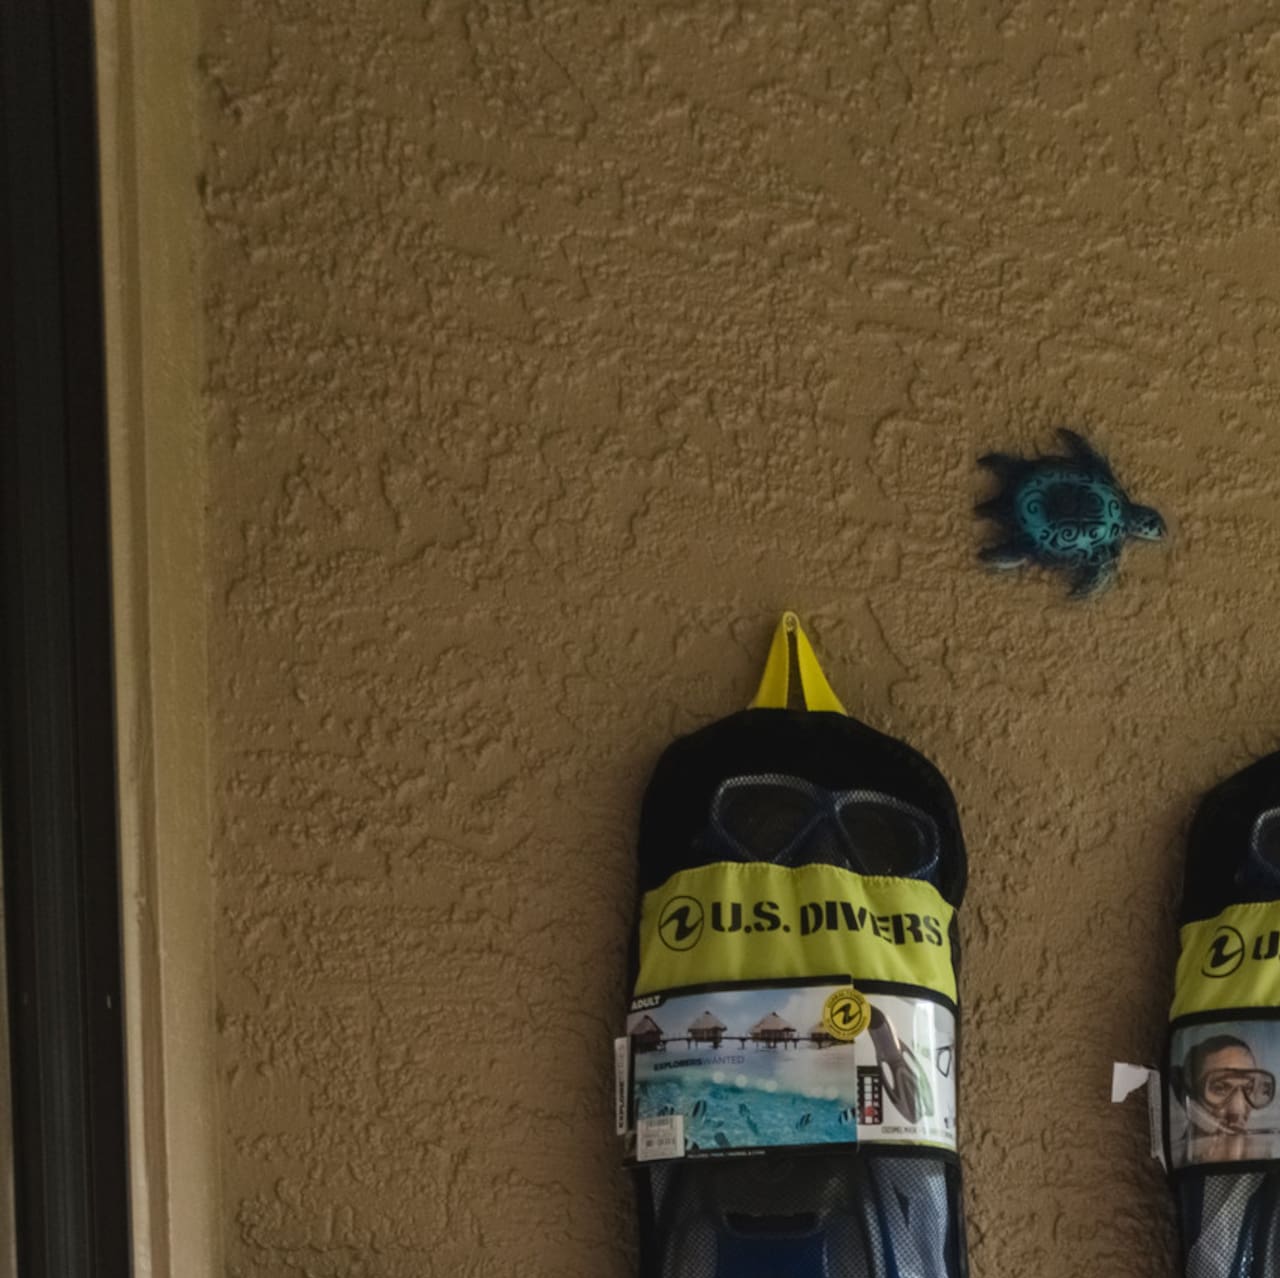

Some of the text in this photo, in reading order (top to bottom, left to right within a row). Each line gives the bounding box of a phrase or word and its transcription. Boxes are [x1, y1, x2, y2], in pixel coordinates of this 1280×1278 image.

[711, 901, 943, 947] U.S. DIVERS
[631, 996, 661, 1010] ADULT
